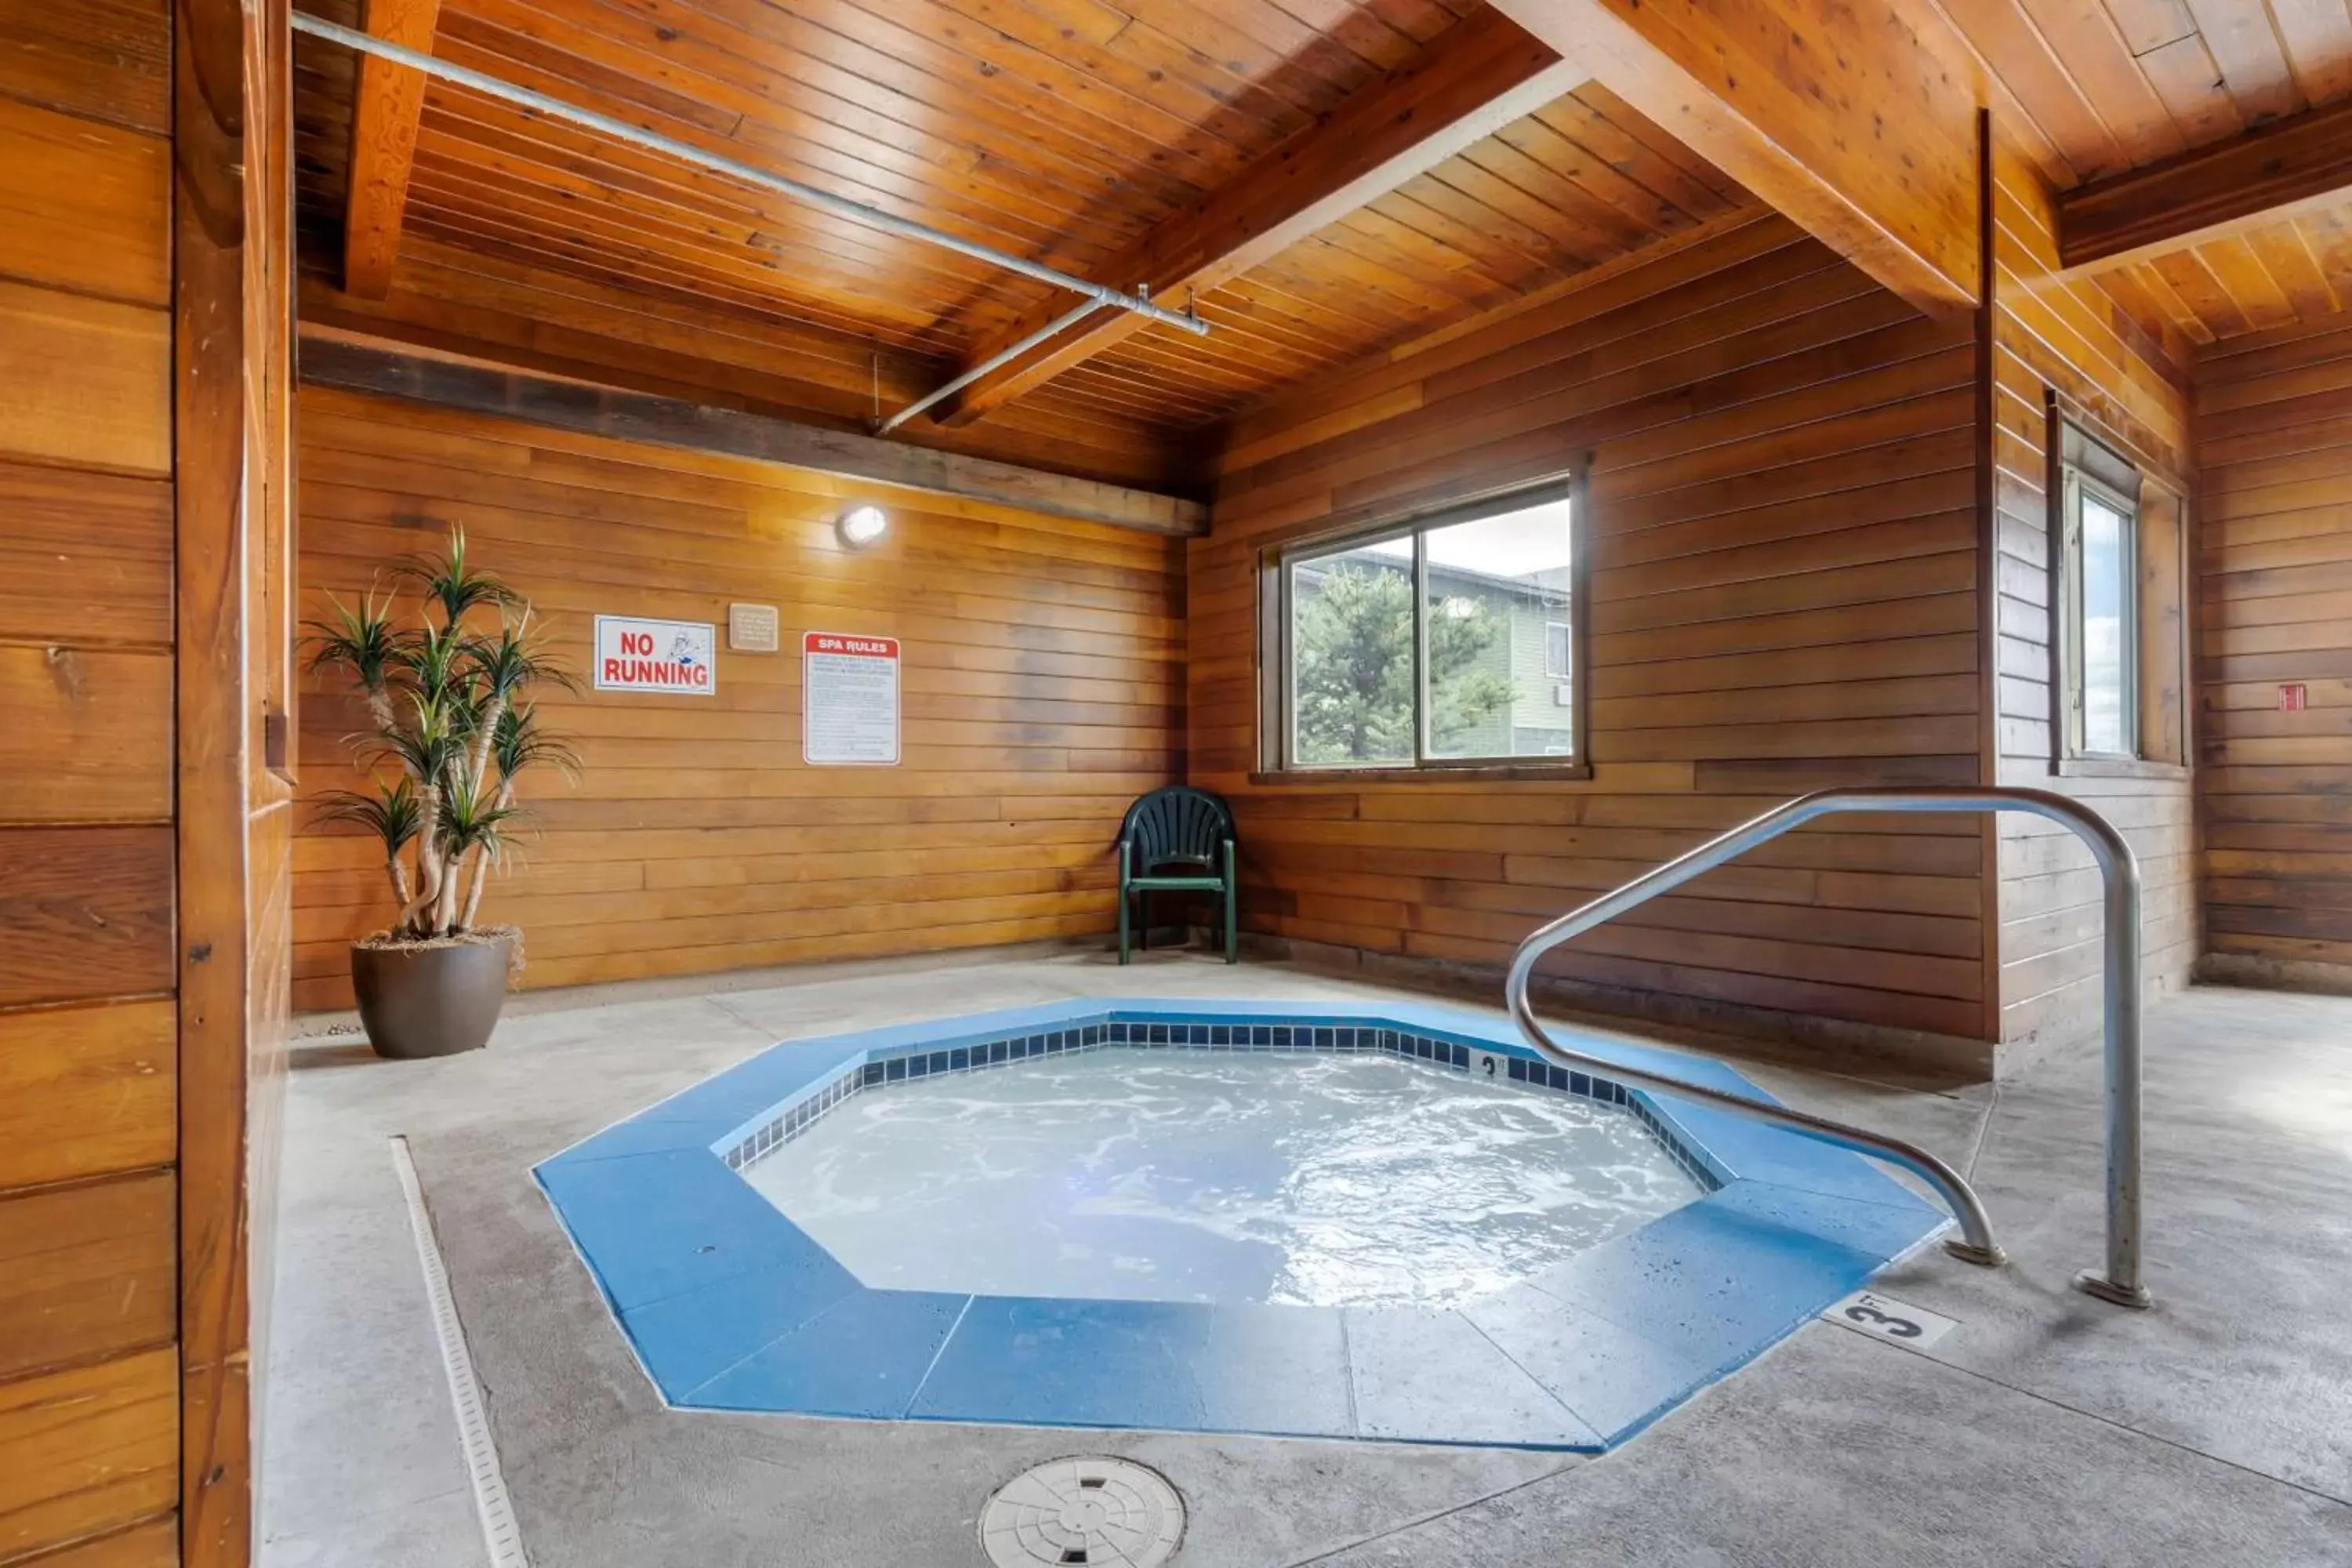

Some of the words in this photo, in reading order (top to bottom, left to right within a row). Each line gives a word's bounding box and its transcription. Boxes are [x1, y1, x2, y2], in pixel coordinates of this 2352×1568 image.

[621, 632, 654, 654] NO
[818, 638, 844, 651] SPA
[846, 641, 888, 653] RULES
[604, 659, 709, 686] RUNNING
[1845, 1305, 1923, 1338] 3
